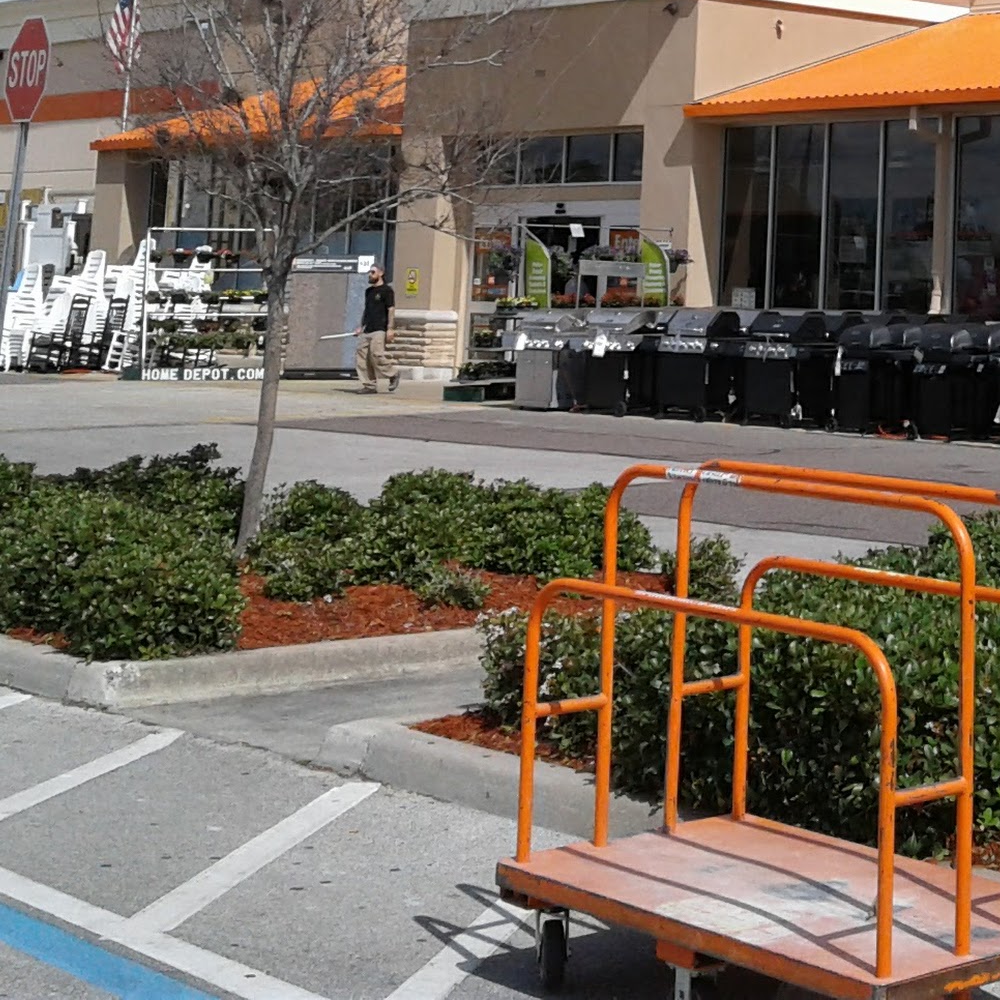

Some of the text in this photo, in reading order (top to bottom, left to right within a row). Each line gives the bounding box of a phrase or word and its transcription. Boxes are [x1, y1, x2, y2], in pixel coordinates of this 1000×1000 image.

[8, 49, 47, 88] STOP
[141, 367, 265, 380] HOME DEPOT.COM
